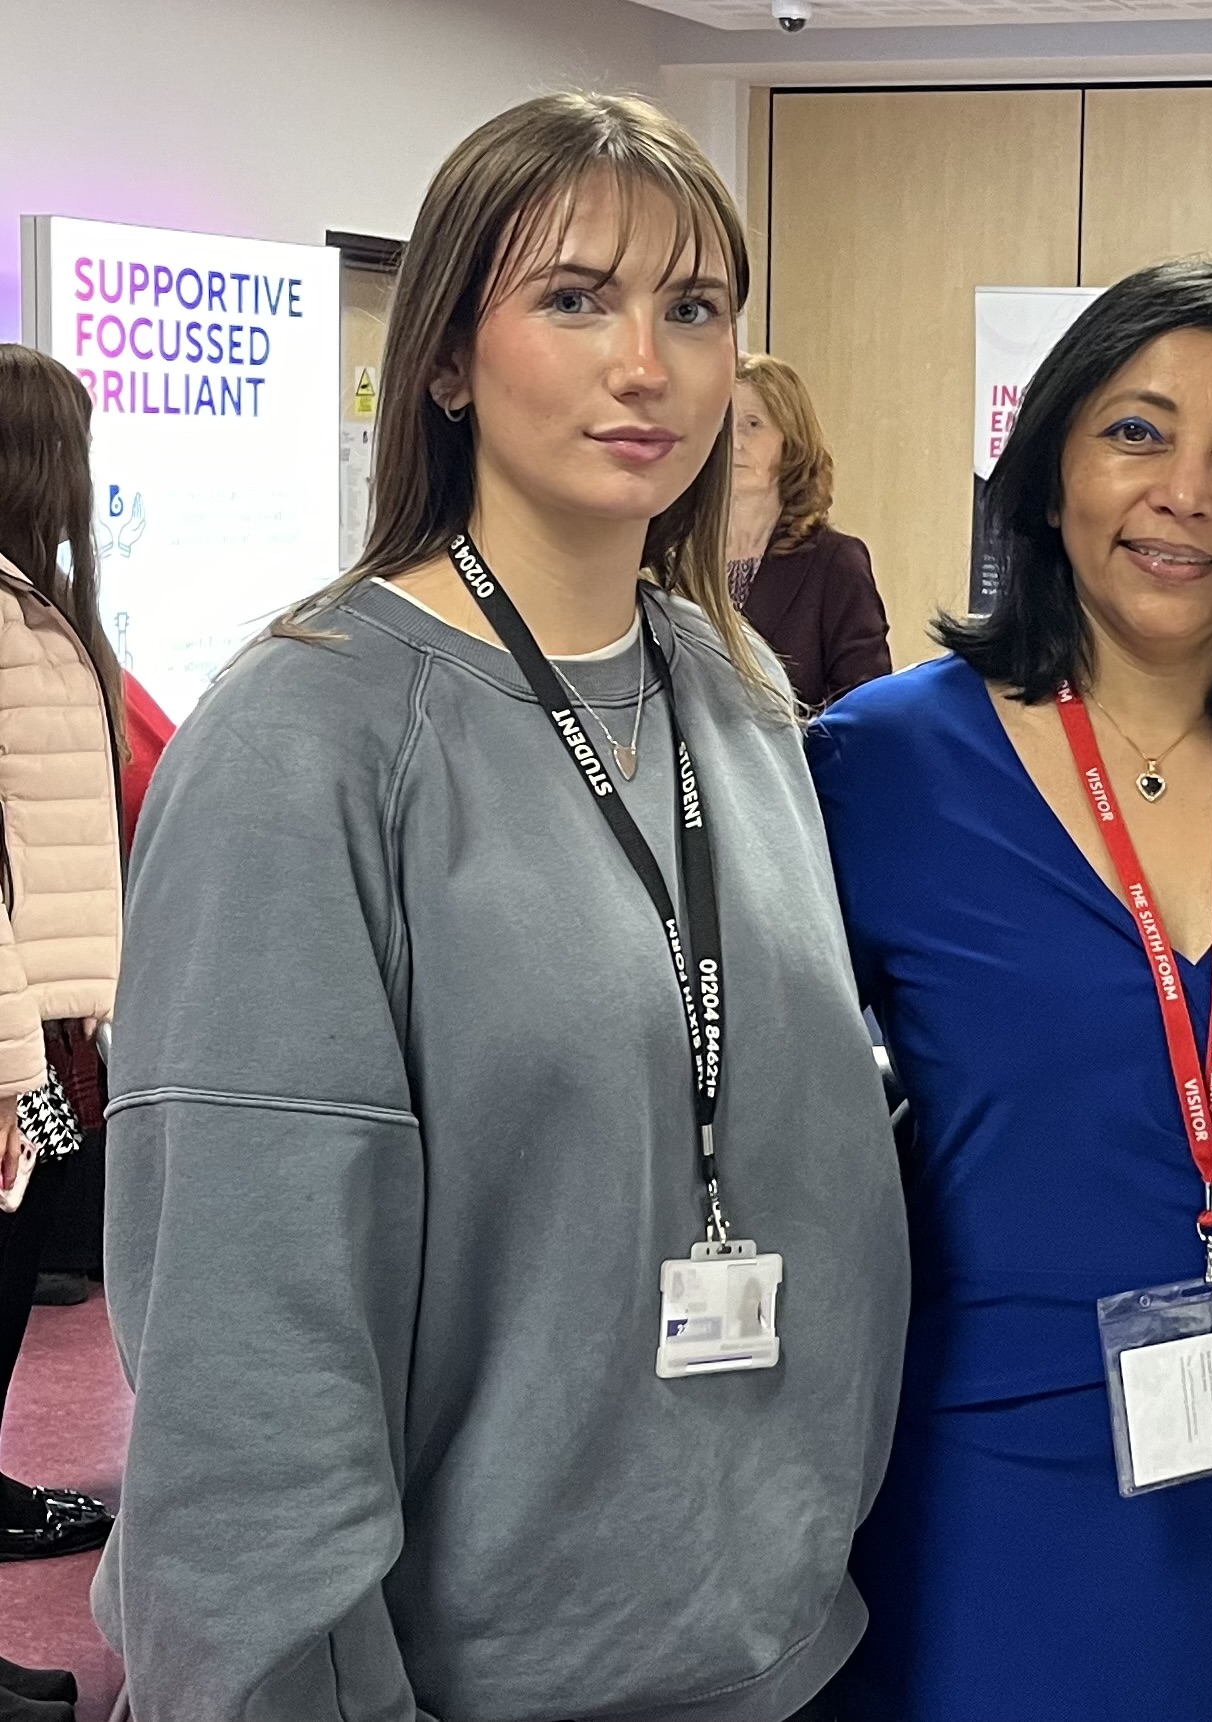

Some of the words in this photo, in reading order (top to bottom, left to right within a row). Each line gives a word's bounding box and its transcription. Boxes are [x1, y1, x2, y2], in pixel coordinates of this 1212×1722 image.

[74, 257, 304, 318] SUPPORTIVE
[76, 313, 270, 366] FOCUSSED
[992, 385, 1022, 407] IN
[454, 545, 495, 599] 01204
[552, 708, 613, 797] STUDENT
[678, 742, 703, 828] STUDENT
[1085, 767, 1114, 822] VISITOR
[666, 919, 687, 981] FORM
[1128, 882, 1144, 910] THE
[1139, 911, 1163, 953] SIXTH
[1155, 954, 1178, 1001] FORM
[699, 958, 720, 1021] 01204
[1184, 1078, 1209, 1142] VISITOR
